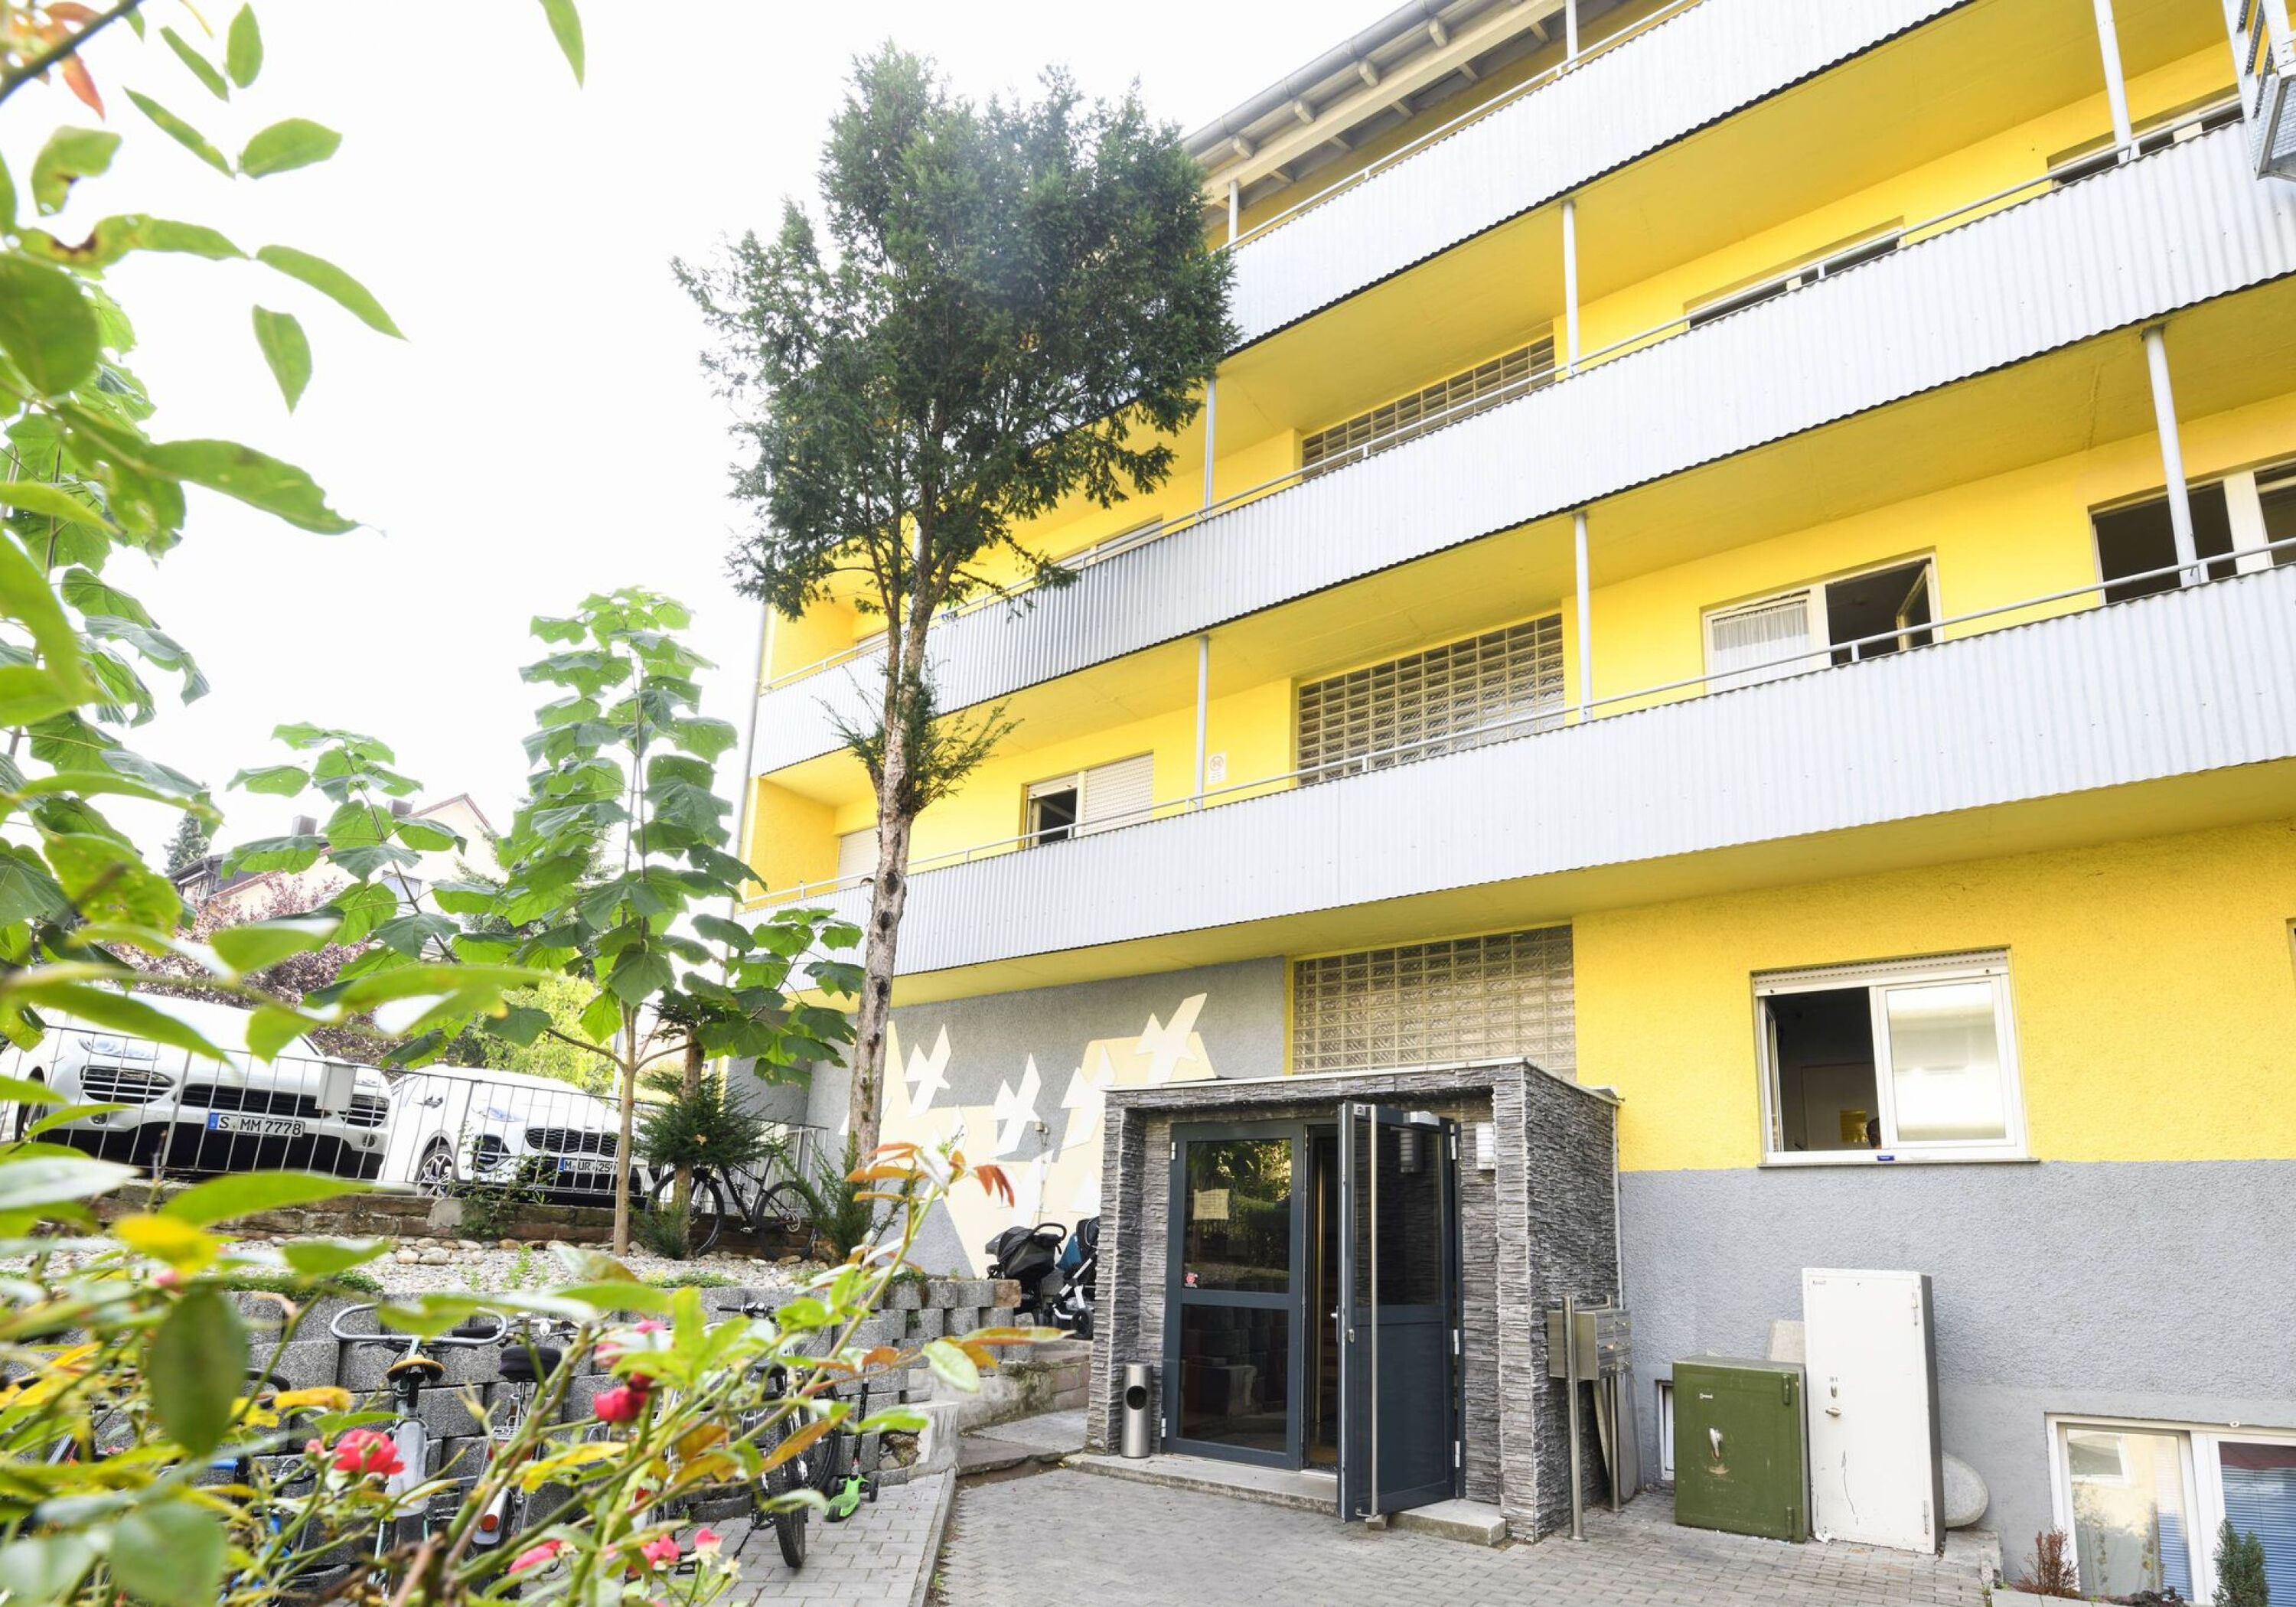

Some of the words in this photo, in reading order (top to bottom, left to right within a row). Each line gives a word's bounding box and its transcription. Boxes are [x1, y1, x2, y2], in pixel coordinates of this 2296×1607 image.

[218, 1116, 230, 1129] S
[240, 1118, 262, 1132] MM
[265, 1120, 301, 1136] 7778
[565, 1160, 572, 1170] M
